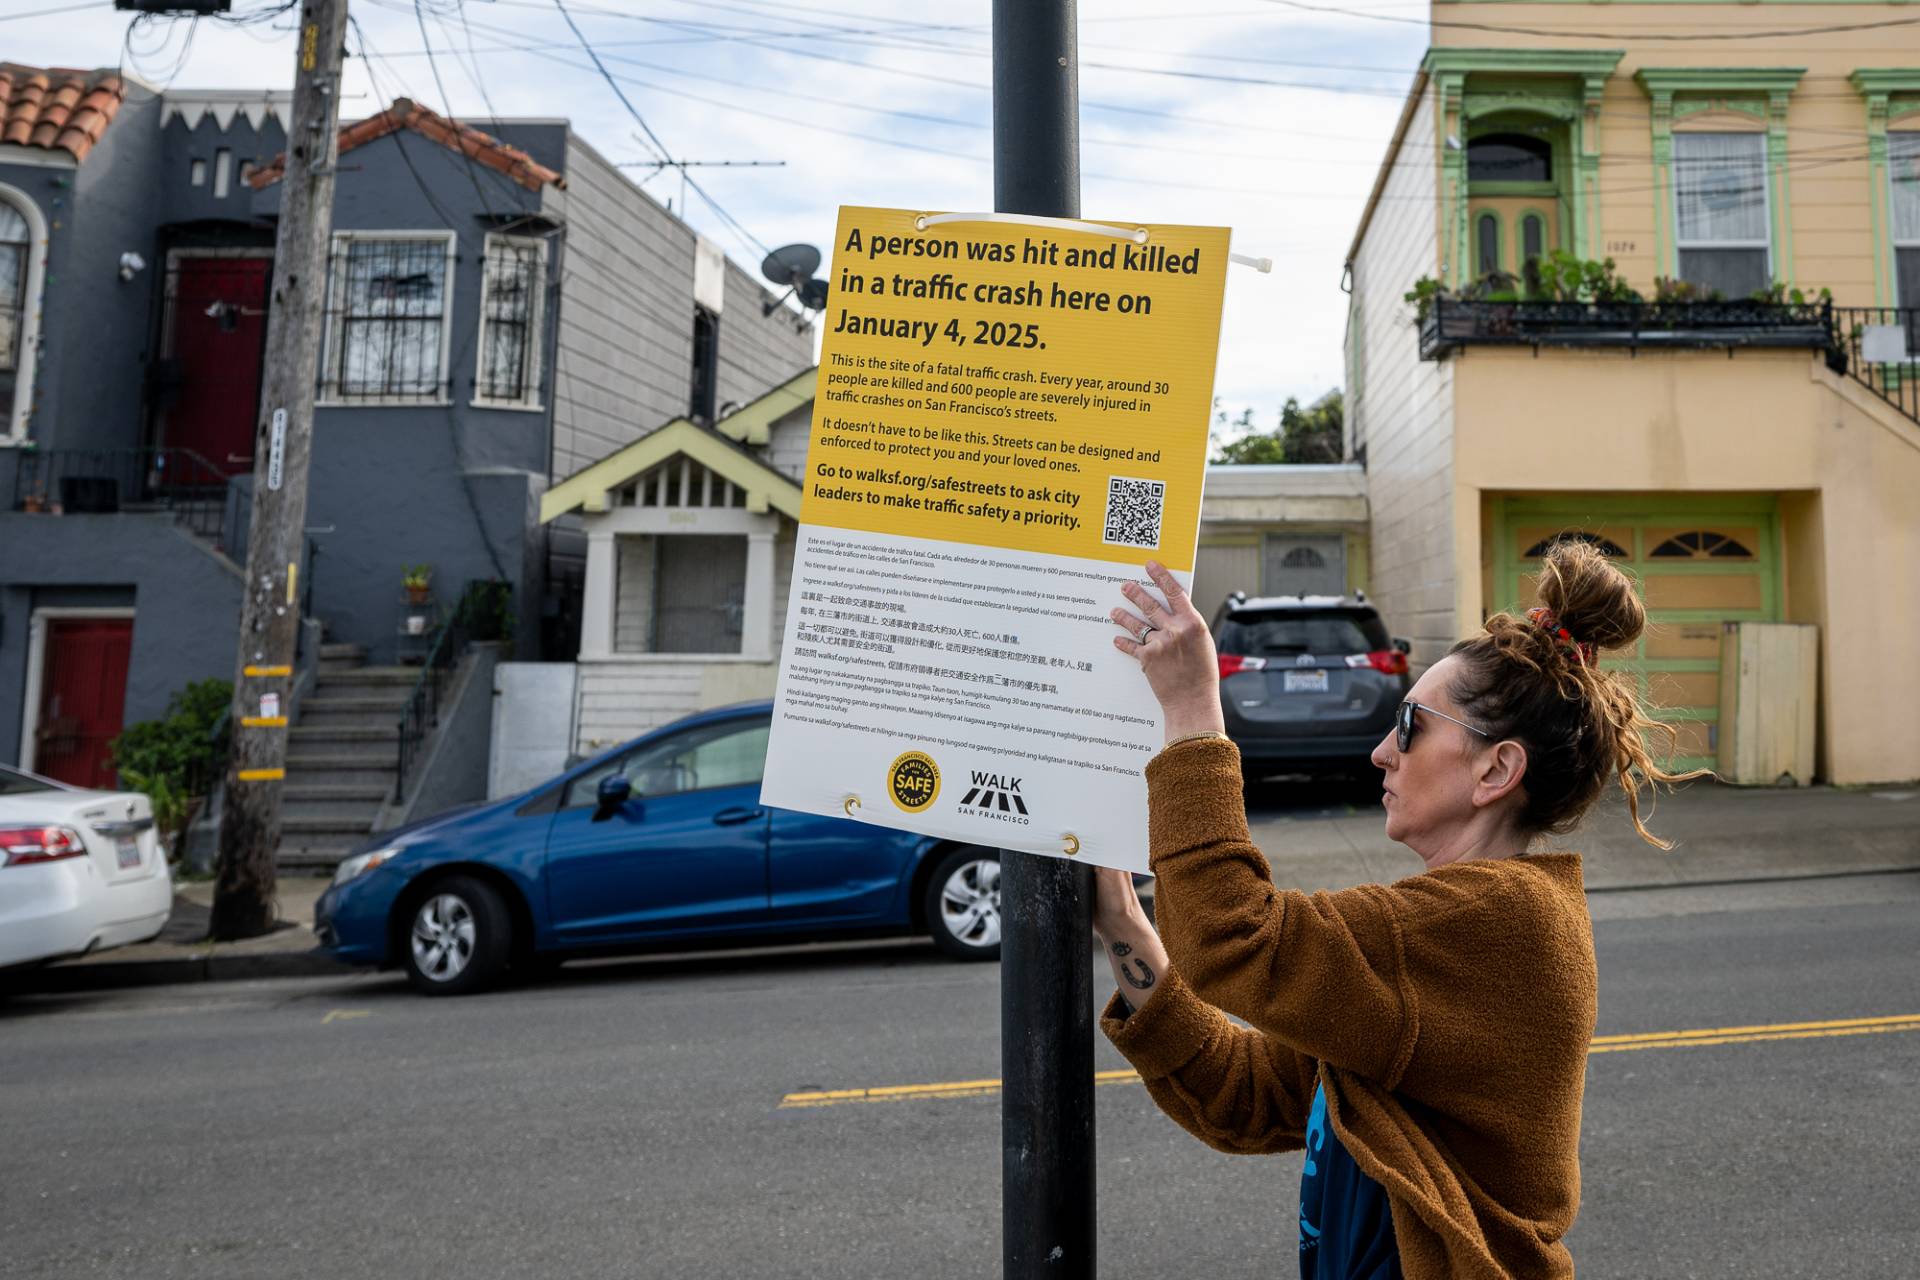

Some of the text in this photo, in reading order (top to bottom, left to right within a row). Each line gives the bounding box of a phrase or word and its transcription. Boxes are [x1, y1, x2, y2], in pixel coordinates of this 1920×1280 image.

[845, 228, 1200, 274] A person was hit and killed
[841, 267, 1151, 314] in a traffic crash here on
[834, 309, 1046, 350] January 4, 2025.
[828, 373, 1151, 412] people are killed and 600 people are severely injured in
[831, 353, 1169, 395] This is the site of a fatal traffic crash. Every year, around 30
[826, 390, 860, 403] traffic
[862, 393, 904, 407] crashes
[907, 399, 922, 409] on
[924, 398, 946, 411] San
[1014, 408, 1057, 422] streets.
[820, 435, 1080, 473] enforced to protect you and your loved ones.
[823, 417, 831, 429] It
[878, 422, 906, 437] have
[909, 426, 921, 438] to
[923, 426, 938, 440] be
[941, 428, 962, 443] like
[964, 431, 989, 445] this.
[992, 434, 1033, 450] Streets
[1036, 441, 1057, 452] can
[1060, 440, 1075, 454] be
[1078, 442, 1134, 461] designed
[1136, 450, 1160, 463] and
[817, 463, 1080, 508] Go to walksf.org/safestreets to ask city
[814, 483, 1080, 531] leaders to make traffic safety a priority.
[896, 774, 932, 793] SAFE
[901, 762, 931, 777] FAMILIES
[971, 770, 1022, 792] WALK
[899, 790, 927, 805] STREETS
[958, 807, 1029, 826] SAN FRANCISCO
